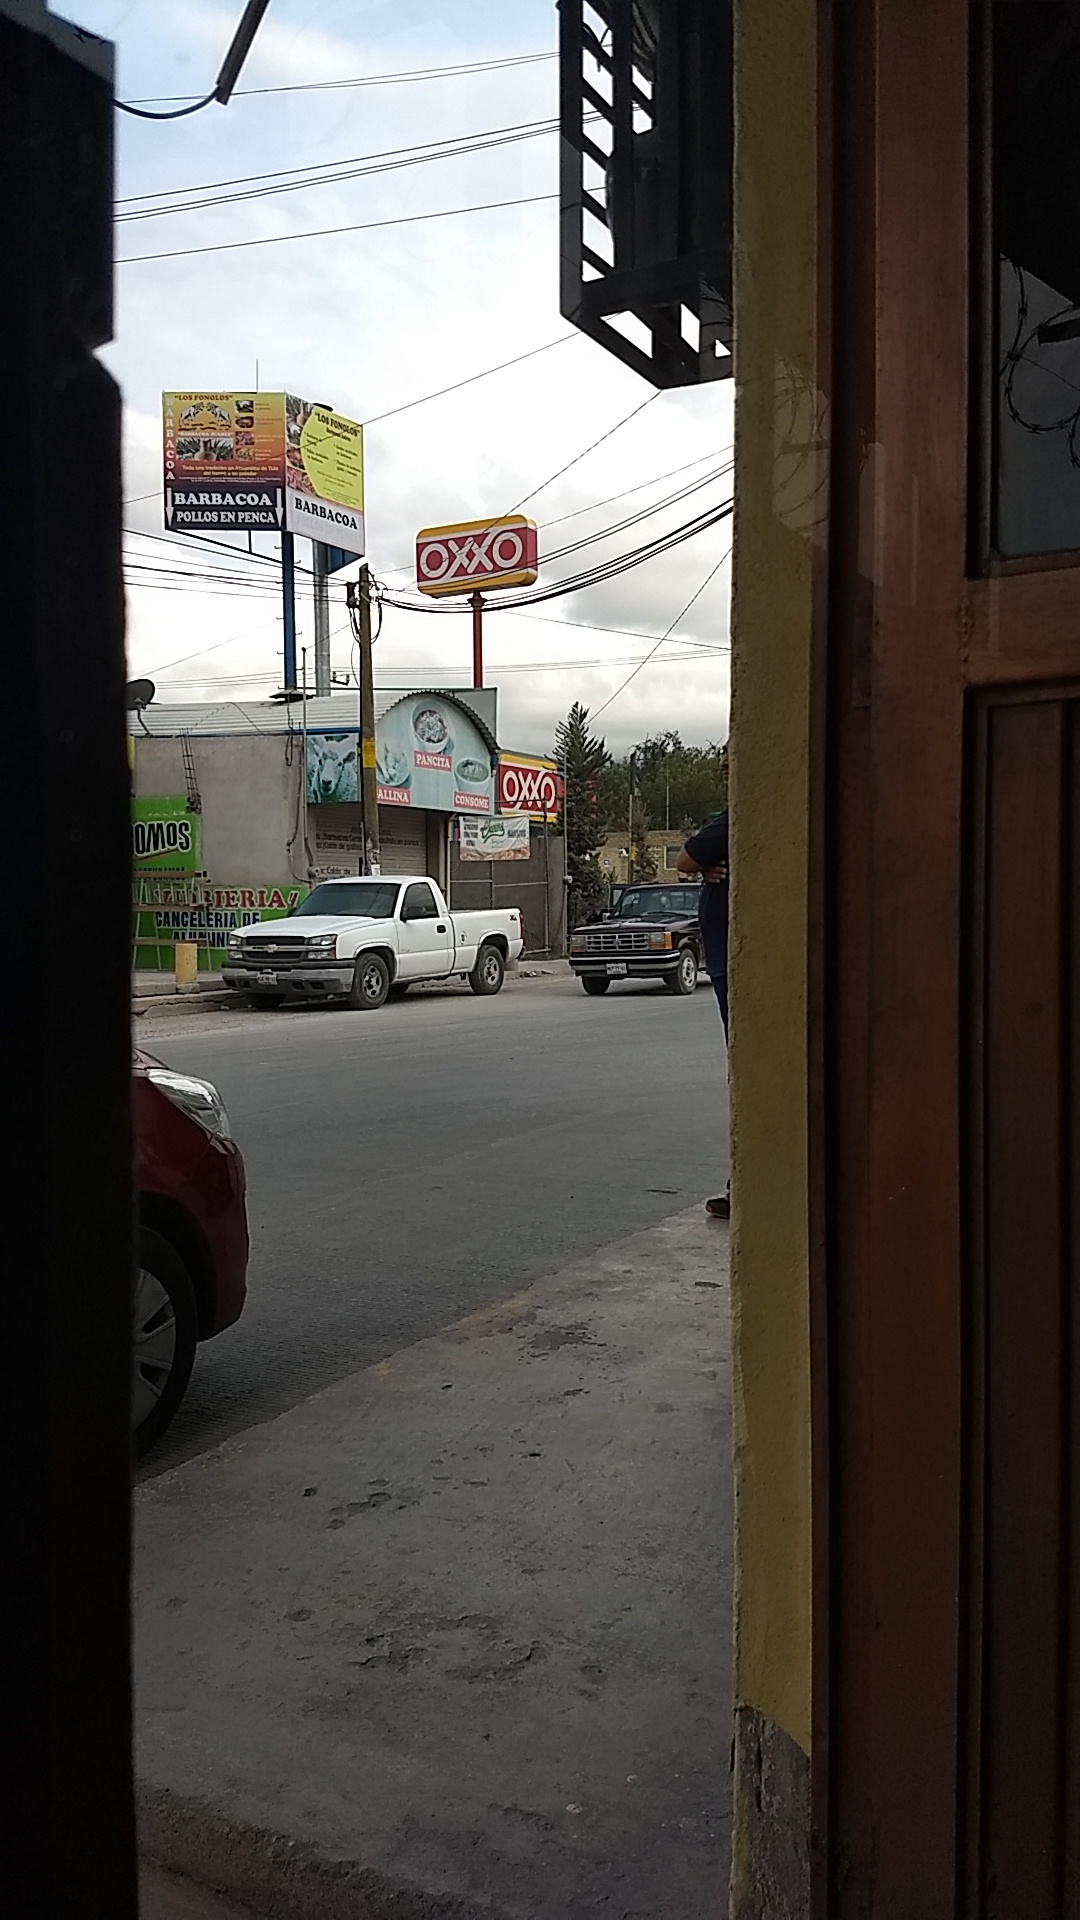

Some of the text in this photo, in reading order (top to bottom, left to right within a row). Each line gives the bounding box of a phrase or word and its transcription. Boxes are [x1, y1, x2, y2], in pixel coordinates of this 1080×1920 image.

[174, 492, 273, 506] BARBACOA
[176, 511, 276, 523] POLLOS EN PENCA
[294, 496, 358, 530] BARBACOA
[420, 532, 523, 579] OXXO
[416, 753, 451, 769] PANCITA
[376, 787, 409, 803] ALLINA
[502, 768, 556, 810] OXXO
[455, 793, 489, 809] CONSOME
[155, 911, 239, 928] CANCELERIA
